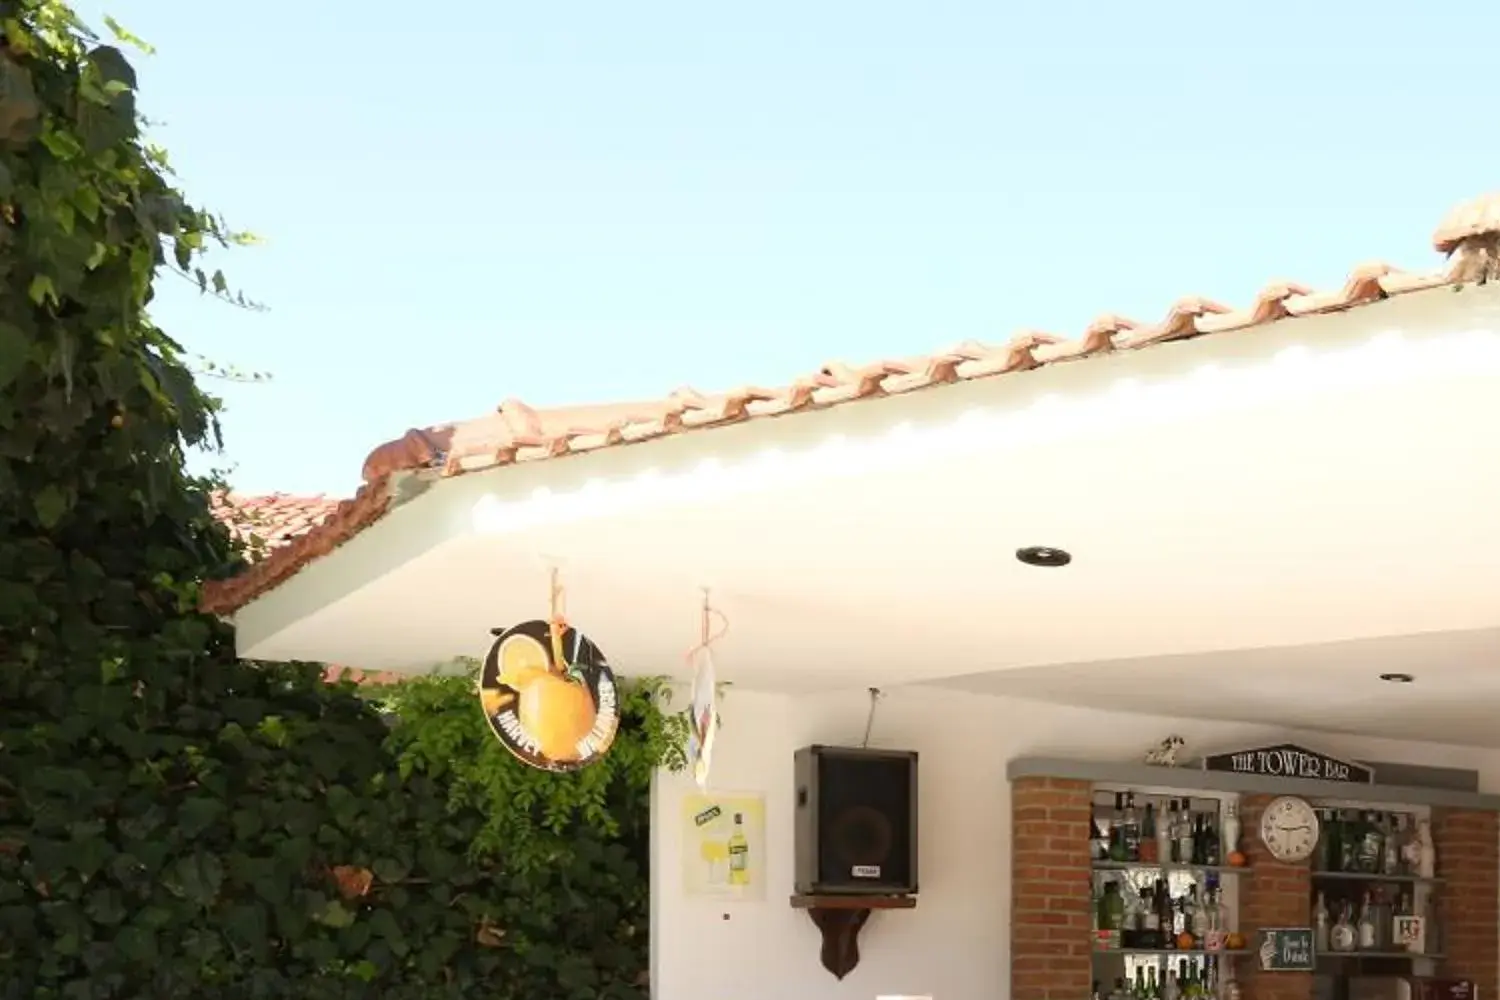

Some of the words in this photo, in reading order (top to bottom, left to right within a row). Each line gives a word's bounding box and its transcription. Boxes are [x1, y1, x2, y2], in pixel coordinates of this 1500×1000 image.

[497, 710, 542, 757] HARVEY
[1231, 753, 1256, 772] THE
[1257, 751, 1321, 777] TOWER
[1325, 760, 1350, 779] BAR
